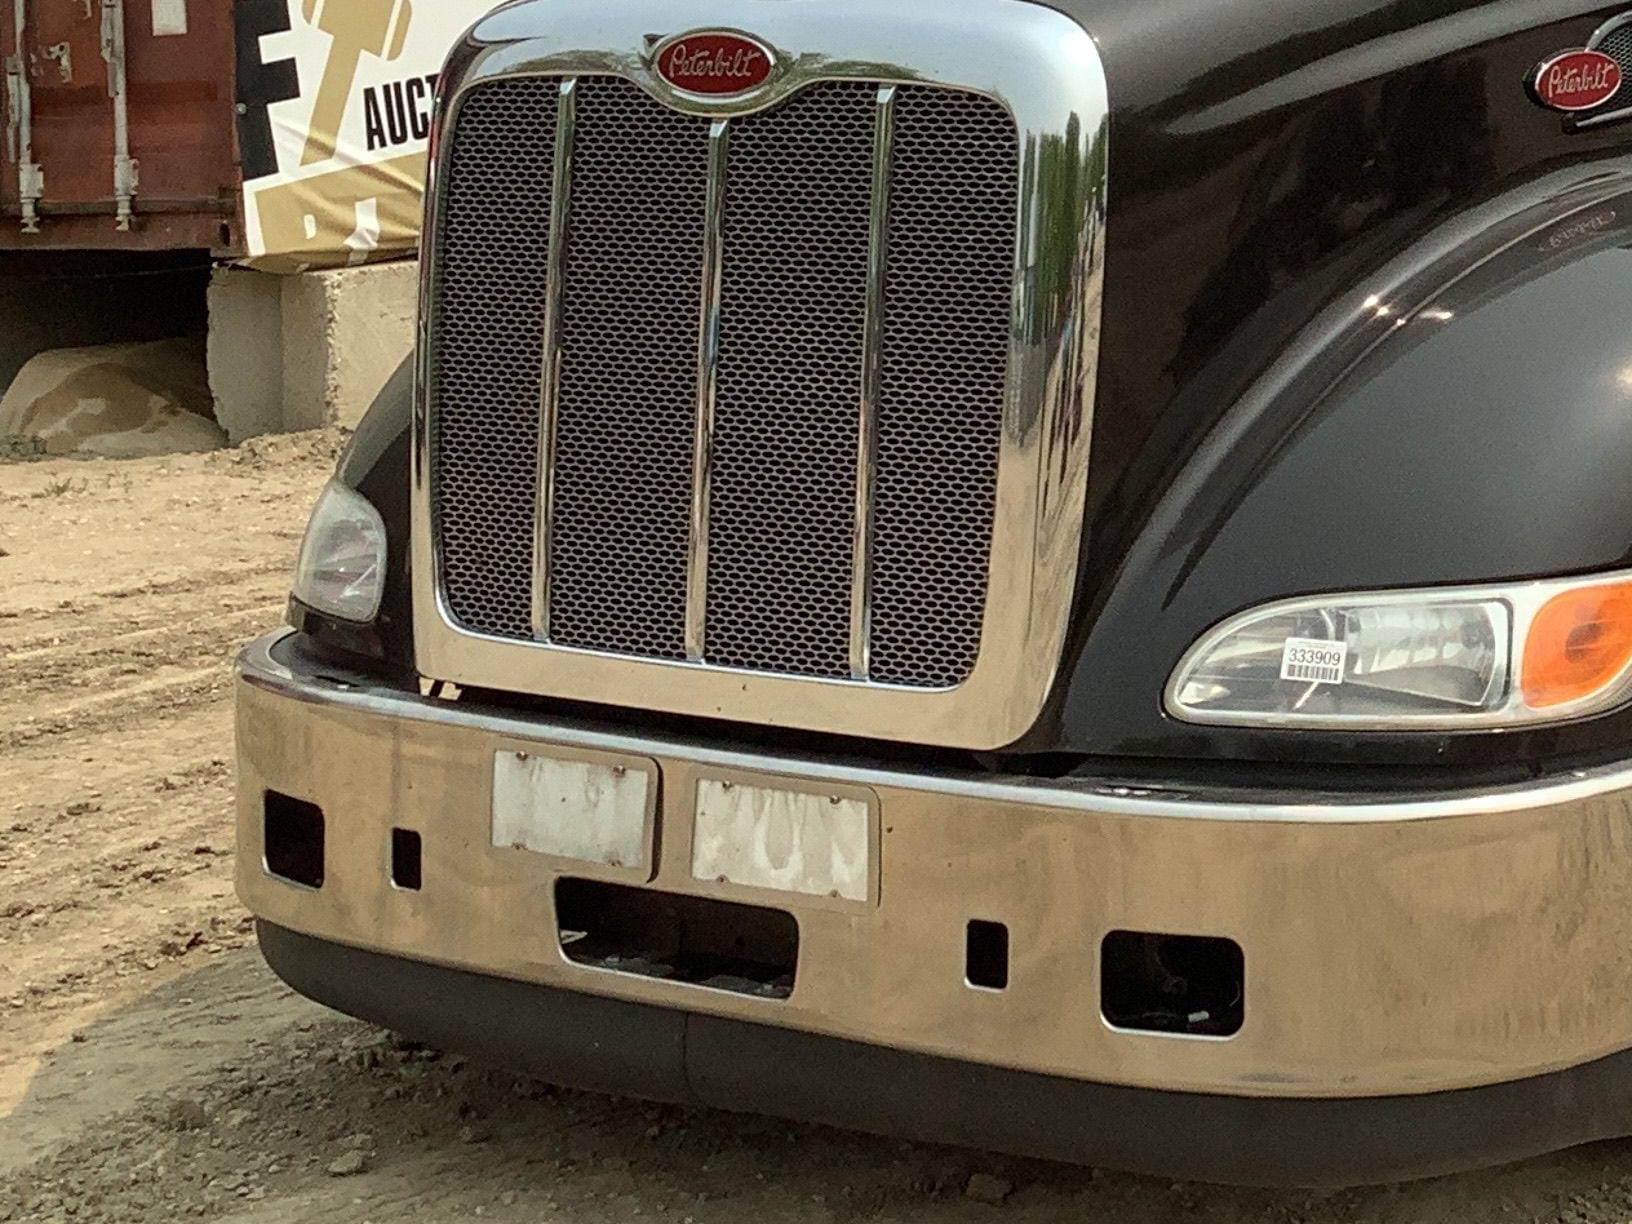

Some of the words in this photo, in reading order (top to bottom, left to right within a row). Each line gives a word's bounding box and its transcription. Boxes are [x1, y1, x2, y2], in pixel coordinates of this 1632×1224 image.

[668, 44, 761, 78] Peterbilt
[1548, 62, 1615, 98] Peterbilt
[1288, 647, 1341, 666] 333909
